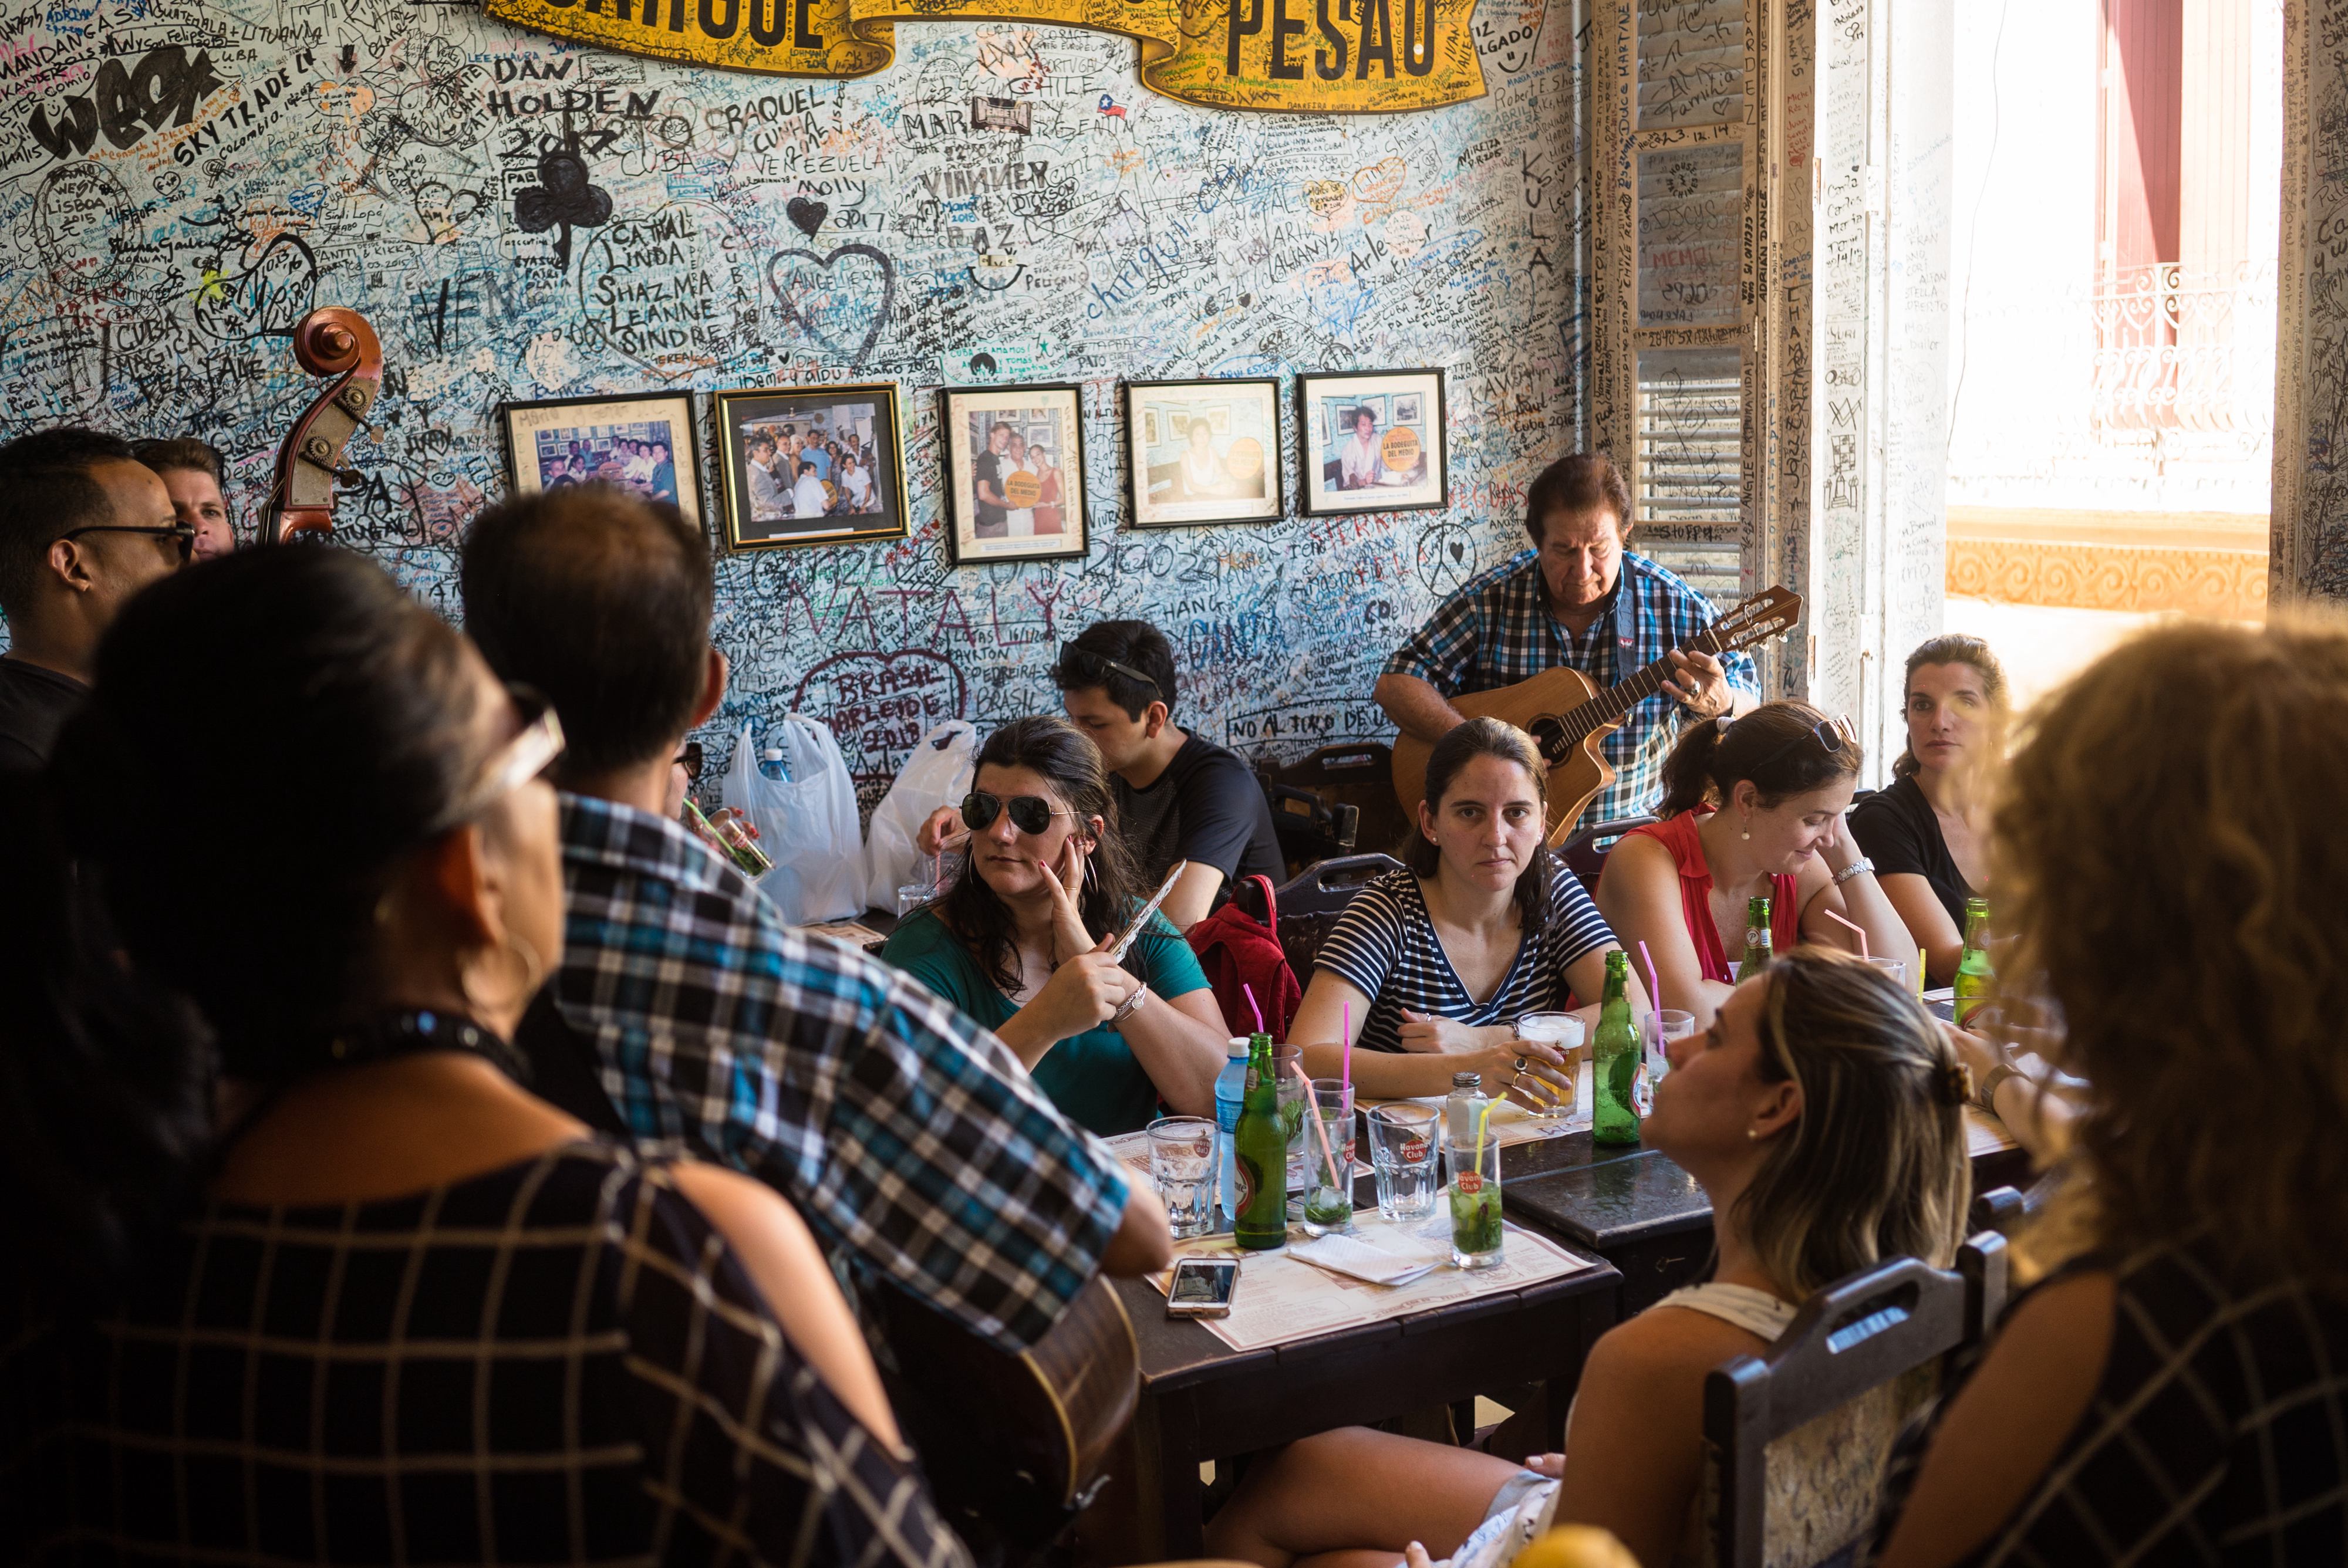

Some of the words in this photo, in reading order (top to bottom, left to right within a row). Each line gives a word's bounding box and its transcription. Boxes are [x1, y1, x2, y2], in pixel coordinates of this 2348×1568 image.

[1227, 0, 1435, 81] PESAO
[1477, 25, 1533, 55] LGADO
[494, 58, 573, 84] DAN
[174, 120, 220, 167] SKY
[221, 67, 292, 129] TRADE
[487, 89, 662, 120] HOLDEN
[725, 85, 825, 134] RAQUEL
[751, 150, 888, 175] VENEZUELA
[834, 210, 885, 229] 2017
[952, 214, 977, 222] 2018
[375, 244, 413, 255] KIKKA
[1783, 253, 1811, 268] CARLOS
[610, 299, 717, 336] LEANNE
[117, 316, 180, 352] CUBA
[1391, 440, 1418, 449] BODEGUITA
[1742, 462, 1754, 509] ANGIE
[829, 664, 945, 704] BRASIL
[864, 722, 920, 753] 2018
[1234, 720, 1257, 738] NO
[1262, 713, 1287, 736] AL
[1749, 933, 1756, 941] P
[1400, 1143, 1431, 1151] Havana
[1406, 1151, 1423, 1159] Club
[1460, 1182, 1478, 1190] Club
